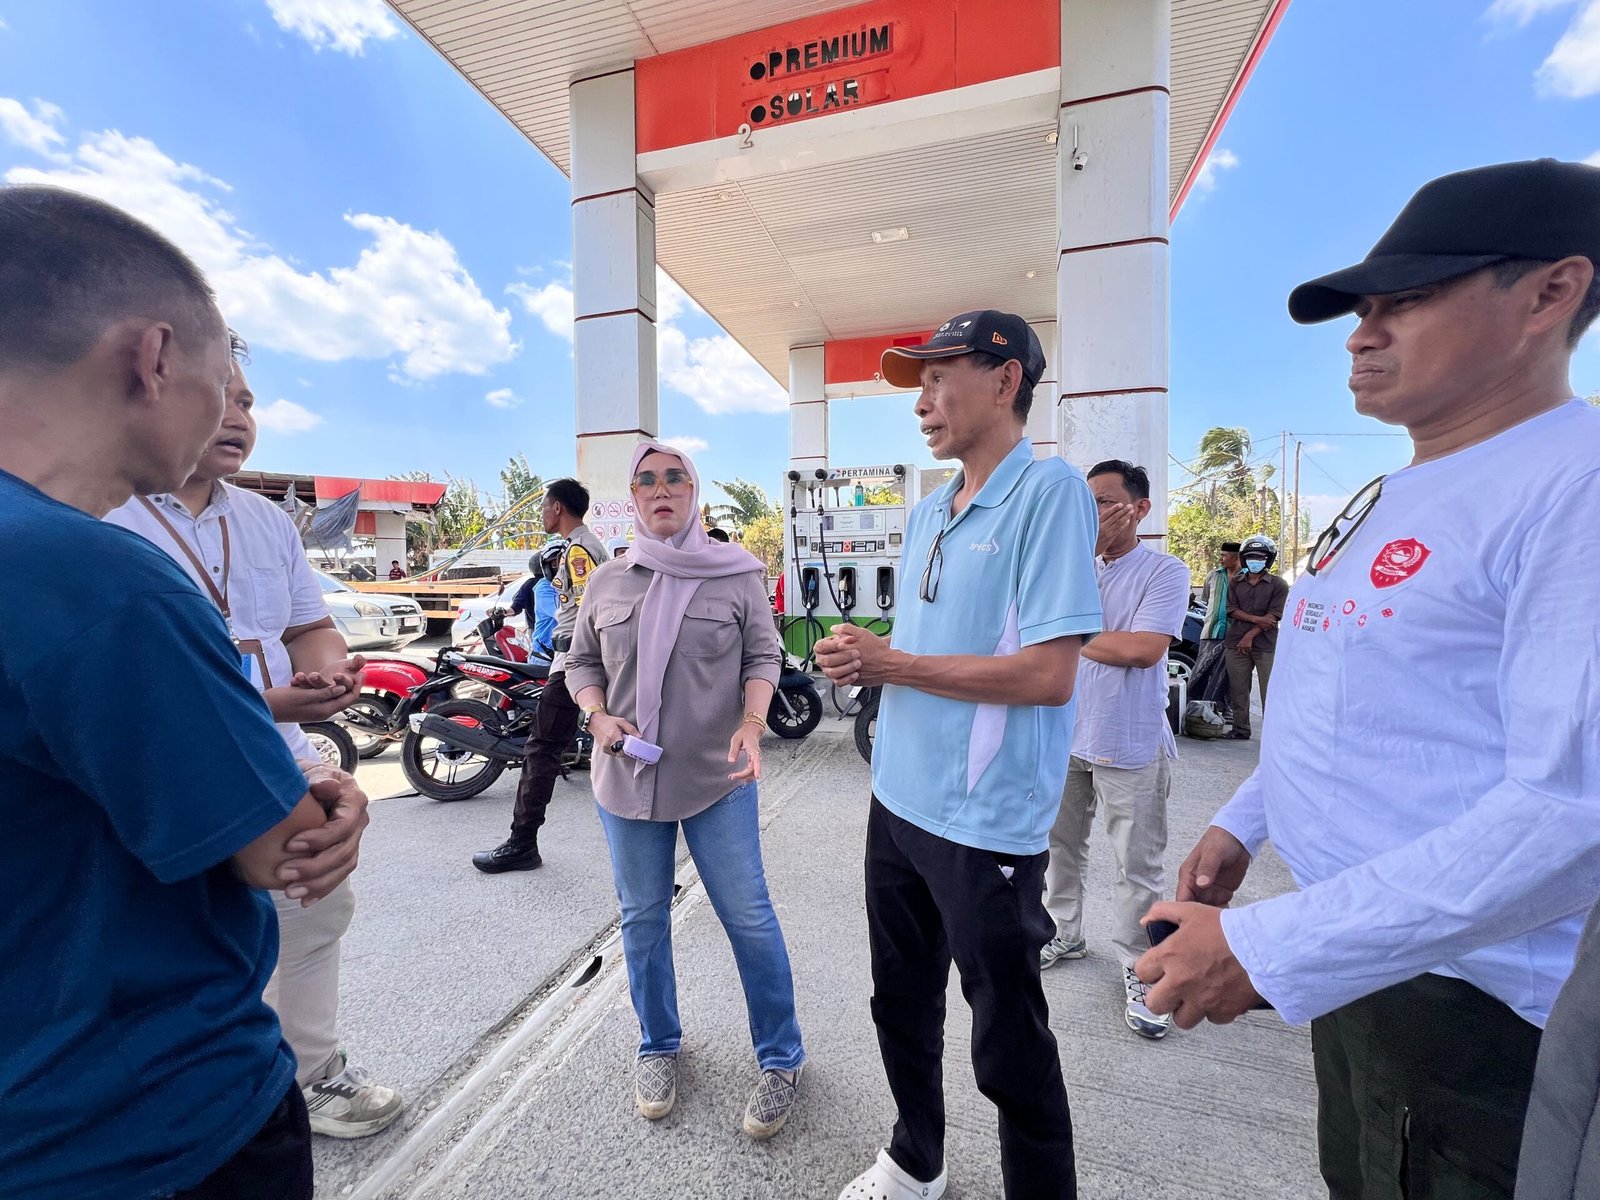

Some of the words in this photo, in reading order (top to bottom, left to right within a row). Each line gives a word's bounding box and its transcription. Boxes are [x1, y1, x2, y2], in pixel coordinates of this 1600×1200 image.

[769, 25, 889, 77] PREMIUM
[770, 79, 859, 120] SOLAR
[738, 123, 753, 149] 2
[873, 371, 881, 384] 3
[841, 468, 890, 477] PERTAMINA
